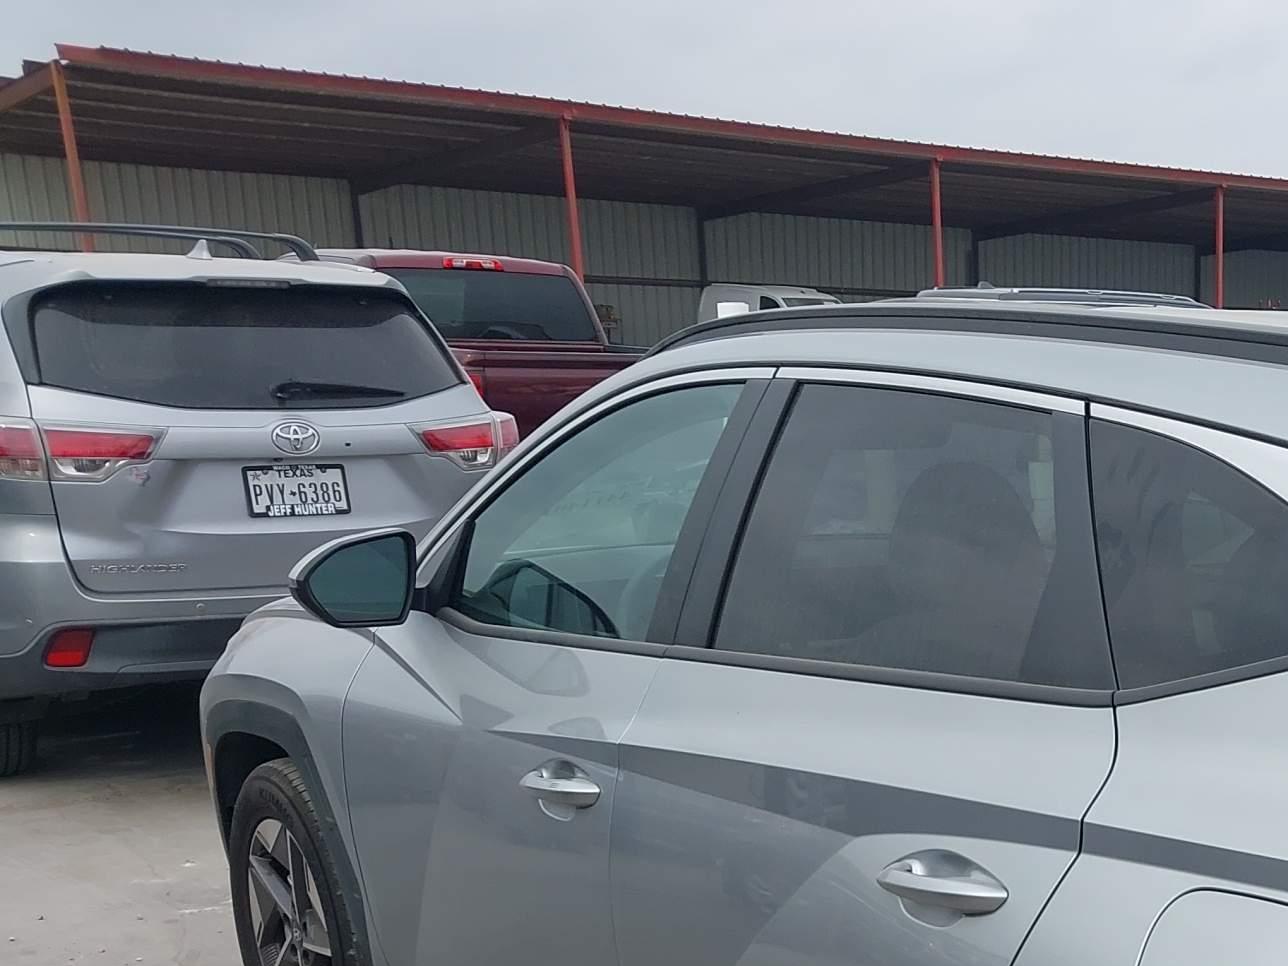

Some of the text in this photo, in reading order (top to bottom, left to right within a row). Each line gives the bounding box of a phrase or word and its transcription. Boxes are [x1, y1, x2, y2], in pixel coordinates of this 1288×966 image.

[277, 469, 314, 478] TEXAS
[268, 503, 335, 516] JEFF HUNTER
